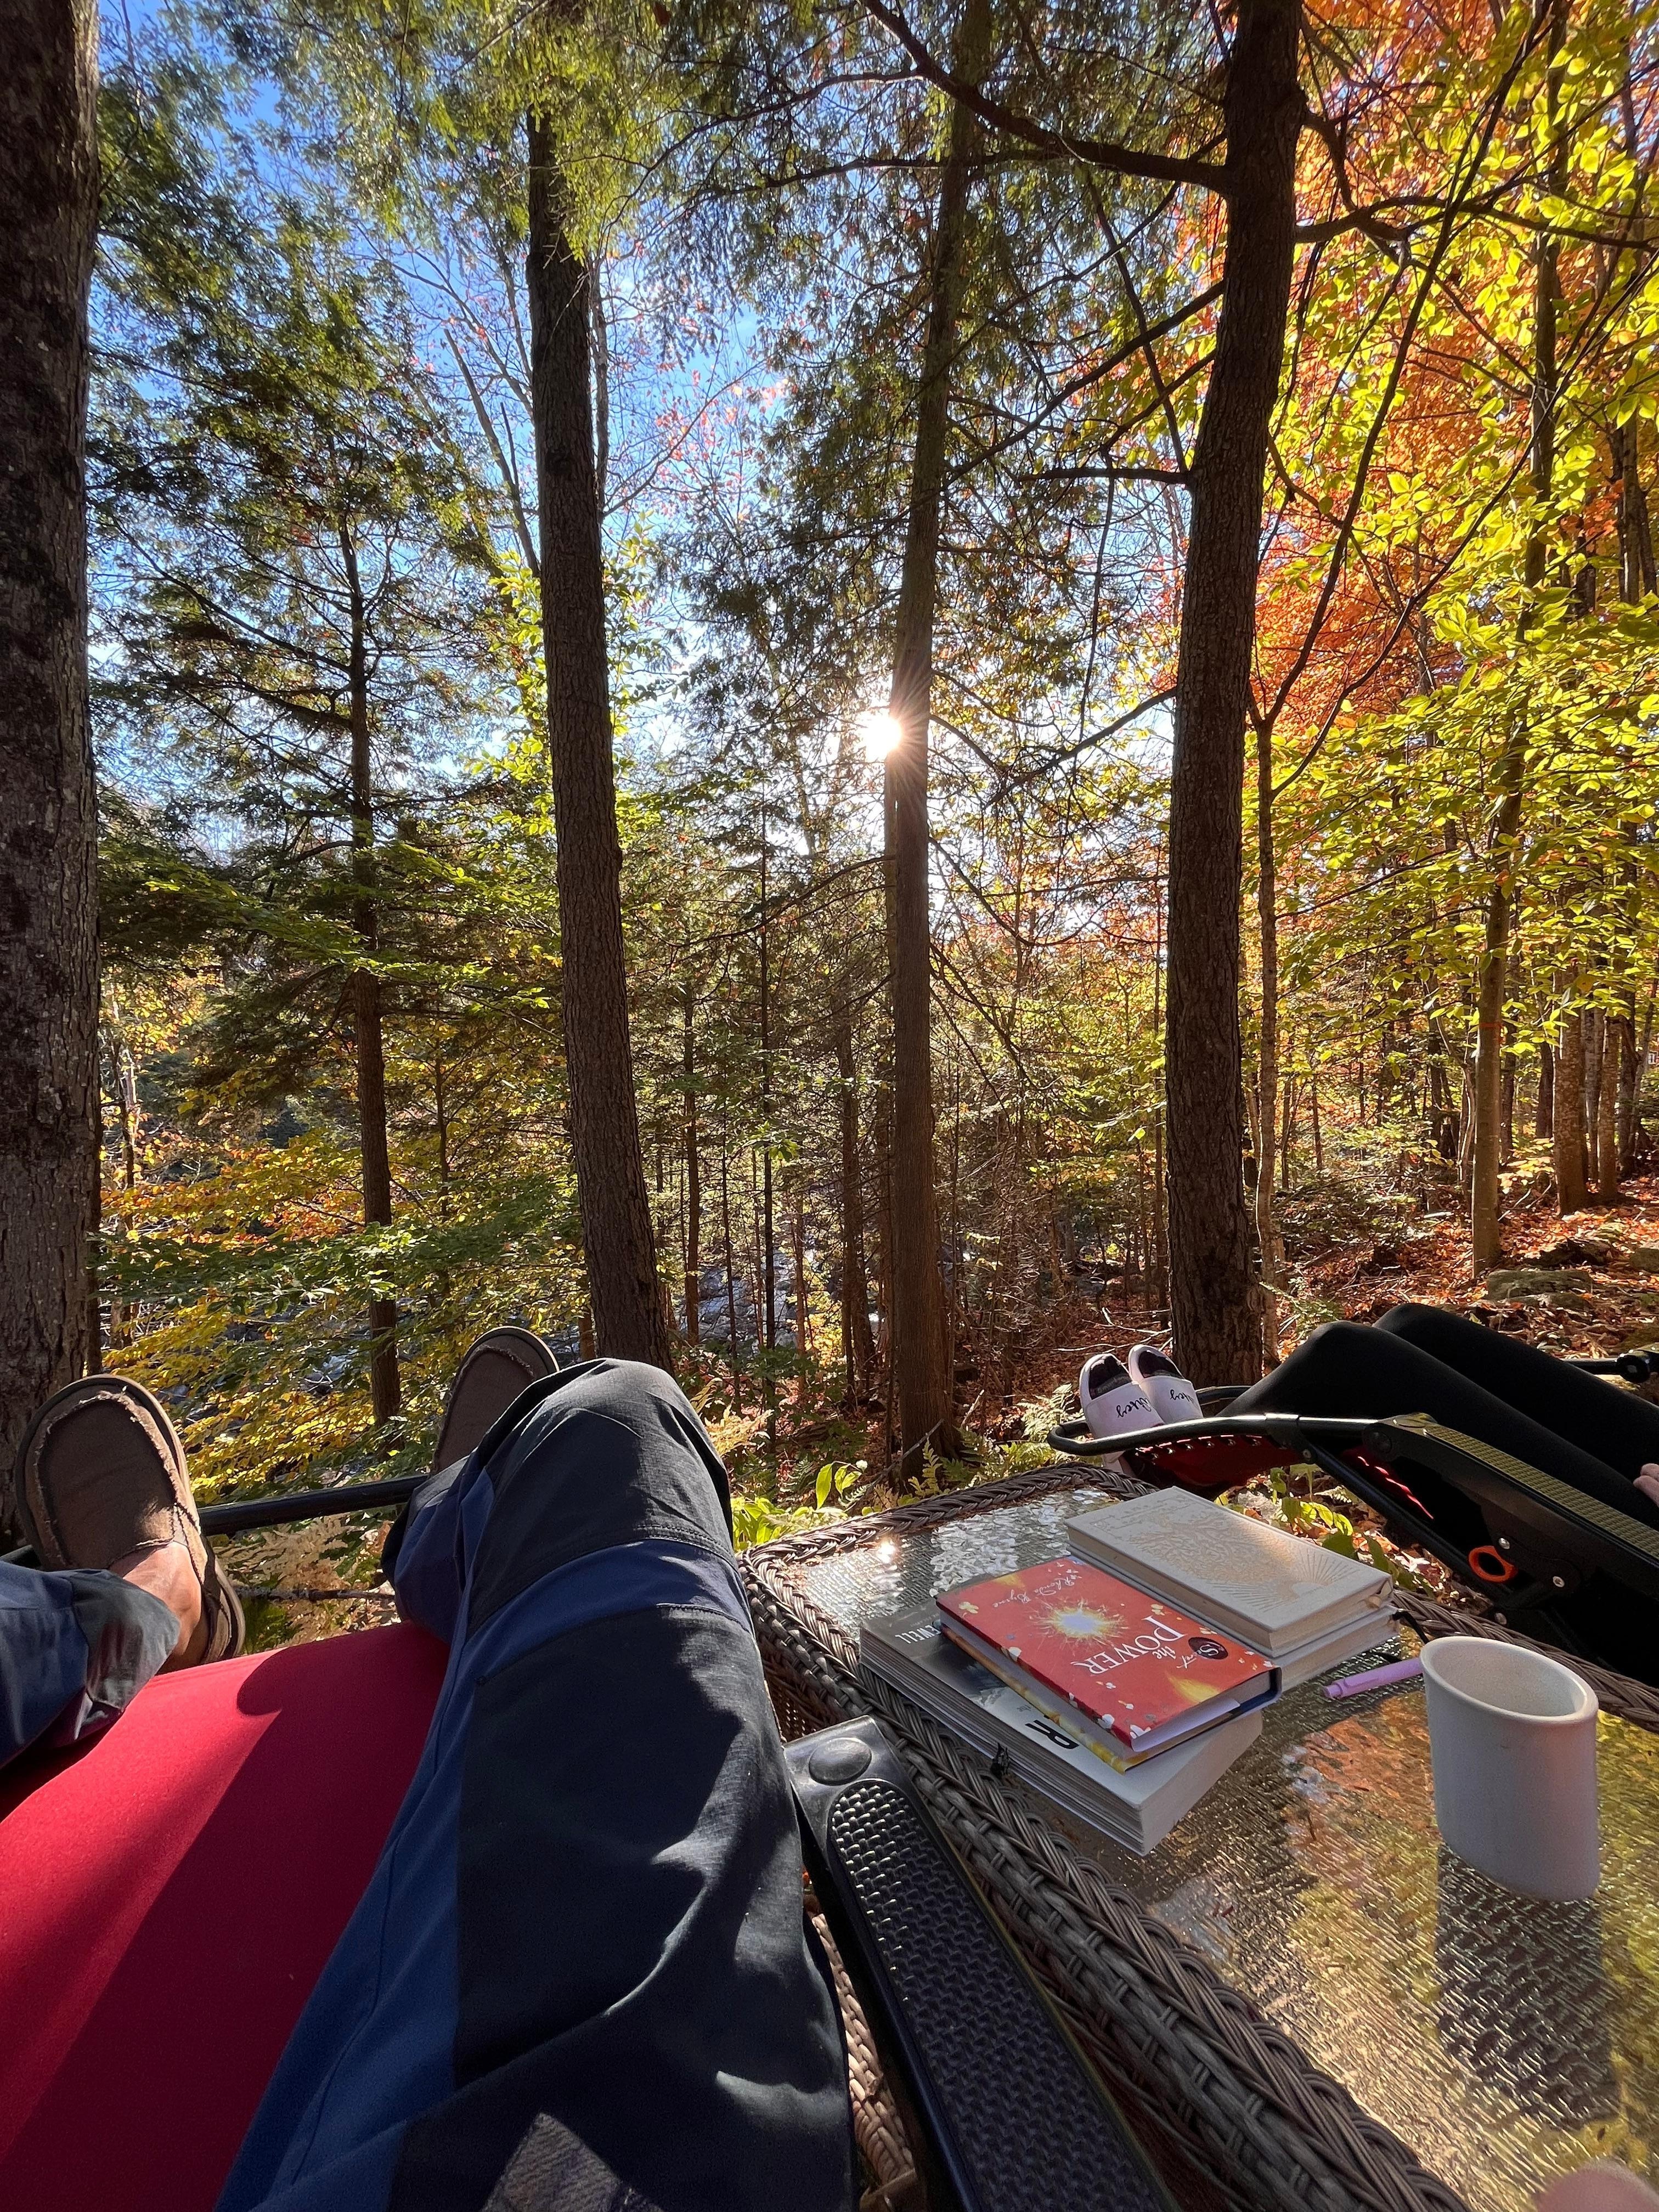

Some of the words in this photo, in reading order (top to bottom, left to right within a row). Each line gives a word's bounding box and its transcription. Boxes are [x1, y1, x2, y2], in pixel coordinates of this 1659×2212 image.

[1034, 1576, 1075, 1596] Rhonda
[992, 1589, 1031, 1608] Byrne
[1070, 1615, 1188, 1674] POWER
[1152, 1645, 1176, 1660] the
[1176, 1642, 1220, 1669] Secret
[1025, 1714, 1080, 1750] R
